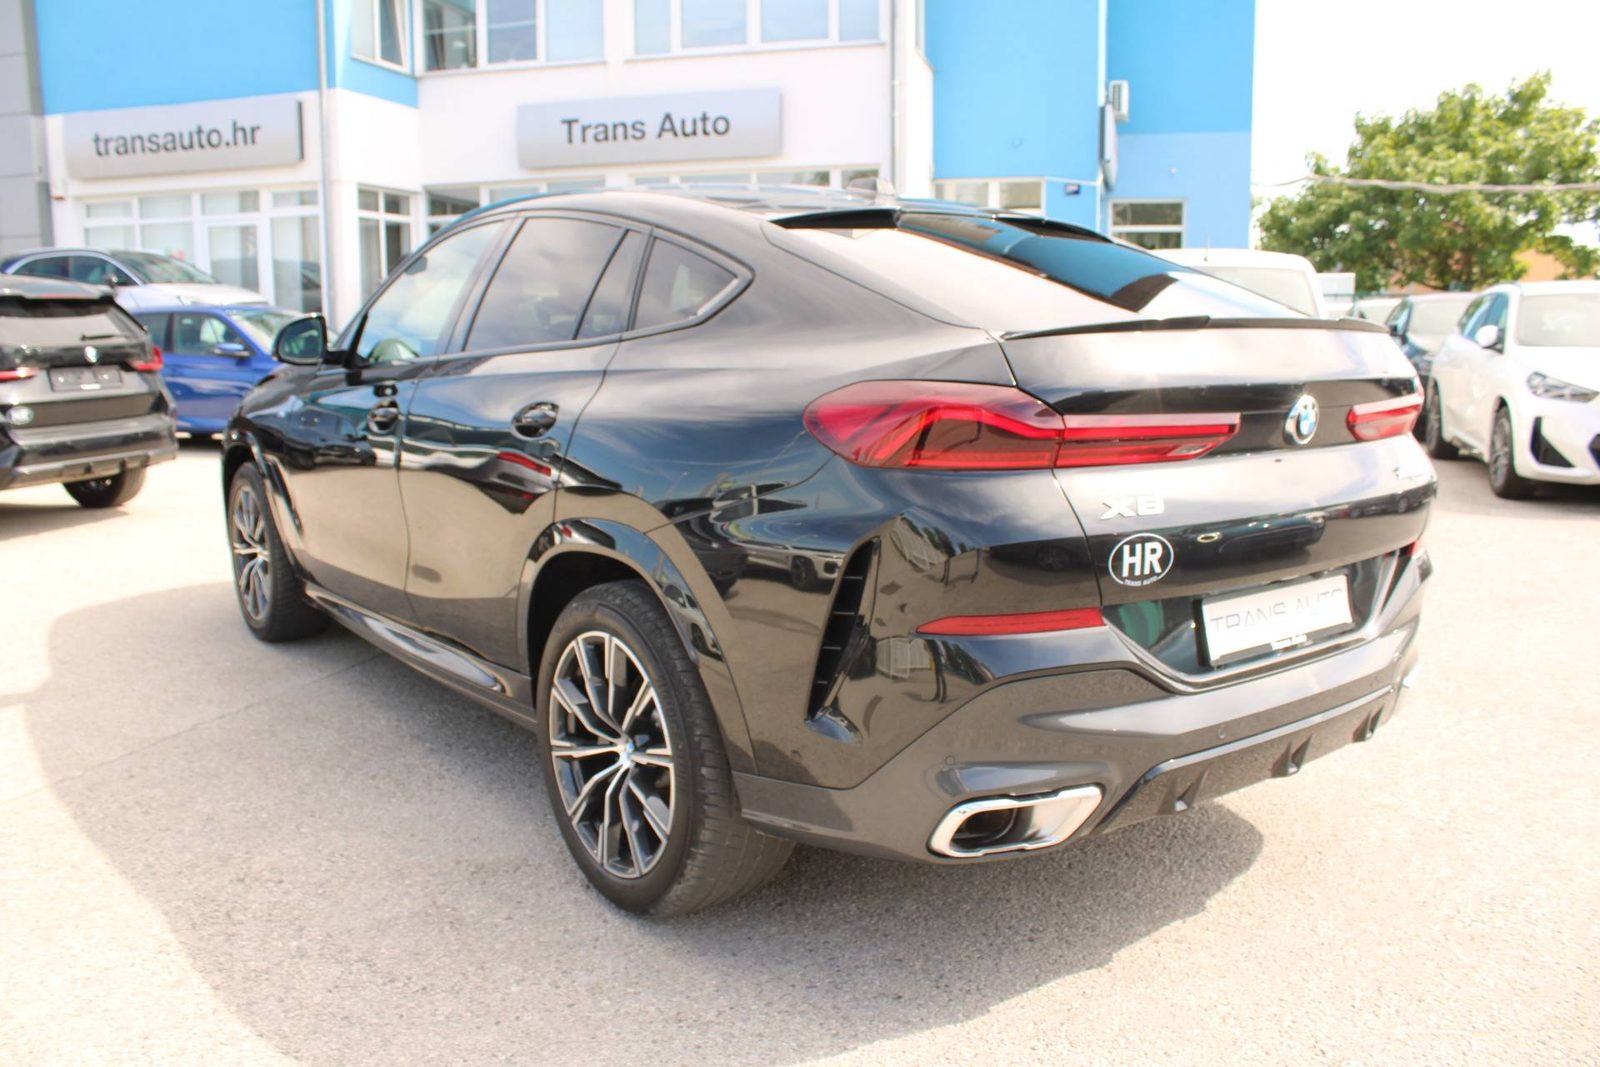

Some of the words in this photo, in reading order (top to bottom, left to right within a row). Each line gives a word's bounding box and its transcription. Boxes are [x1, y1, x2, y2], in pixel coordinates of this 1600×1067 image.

[92, 120, 262, 157] transauto.hr
[561, 115, 647, 145] Trans
[657, 111, 731, 140] Auto
[1100, 497, 1165, 520] X6
[1122, 541, 1163, 578] HR
[1210, 602, 1288, 632] TRANS
